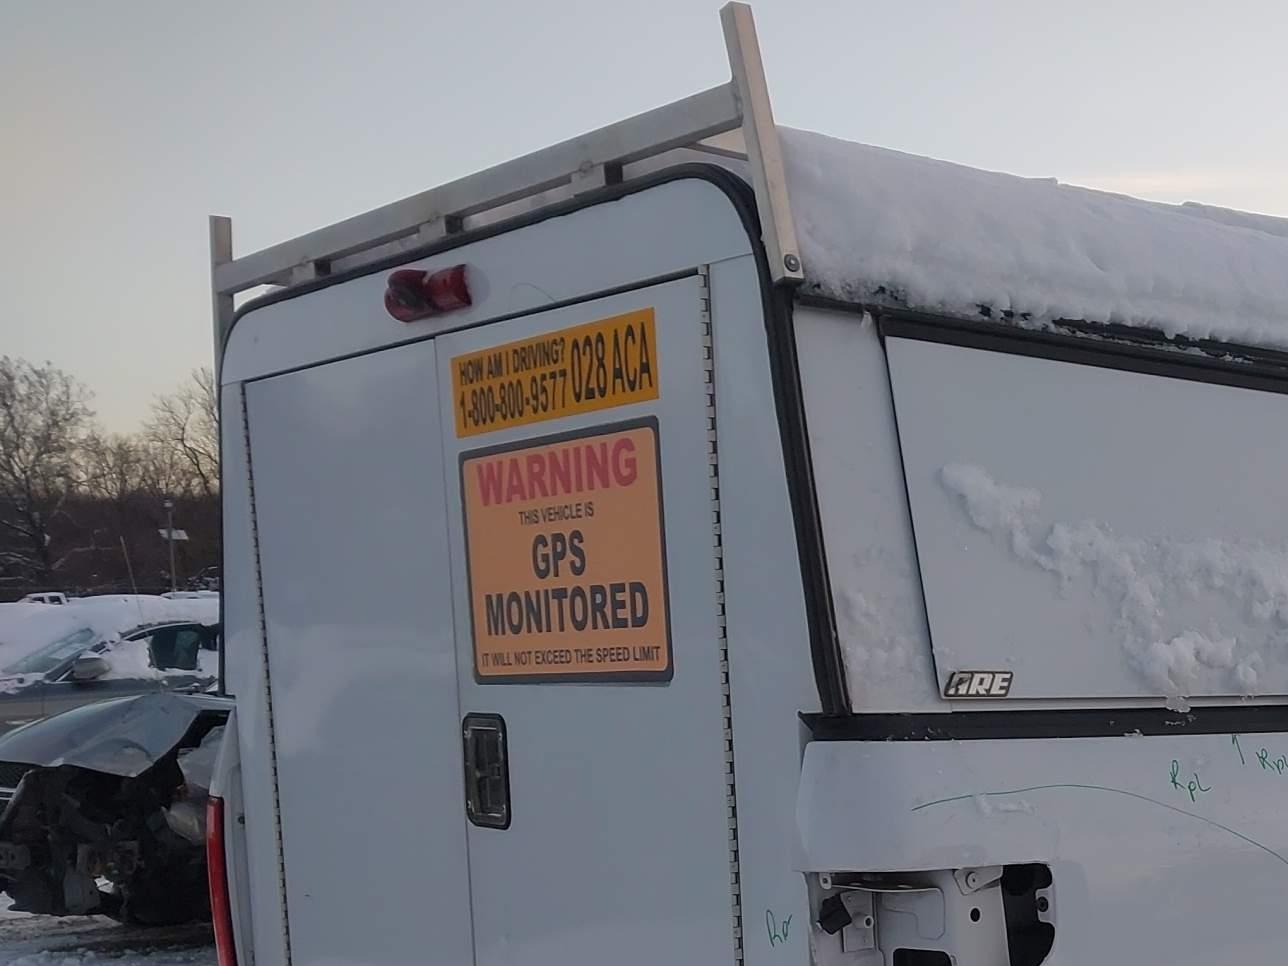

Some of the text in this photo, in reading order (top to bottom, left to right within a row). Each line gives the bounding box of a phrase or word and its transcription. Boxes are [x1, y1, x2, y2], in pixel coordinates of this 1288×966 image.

[459, 360, 483, 386] HOW
[487, 353, 503, 377] AM
[513, 337, 565, 373] DRIVING?
[571, 322, 653, 403] 028 ACA
[460, 369, 568, 429] 1-800-800-9577
[477, 437, 639, 507] WARNING
[518, 502, 594, 526] THIS VEHICLE IS
[532, 530, 586, 579] GPS
[485, 581, 649, 636] MONITORED
[481, 646, 660, 667] IT WILL NOT EXCEED THE SPEED LIMIT
[947, 671, 1011, 696] ARE
